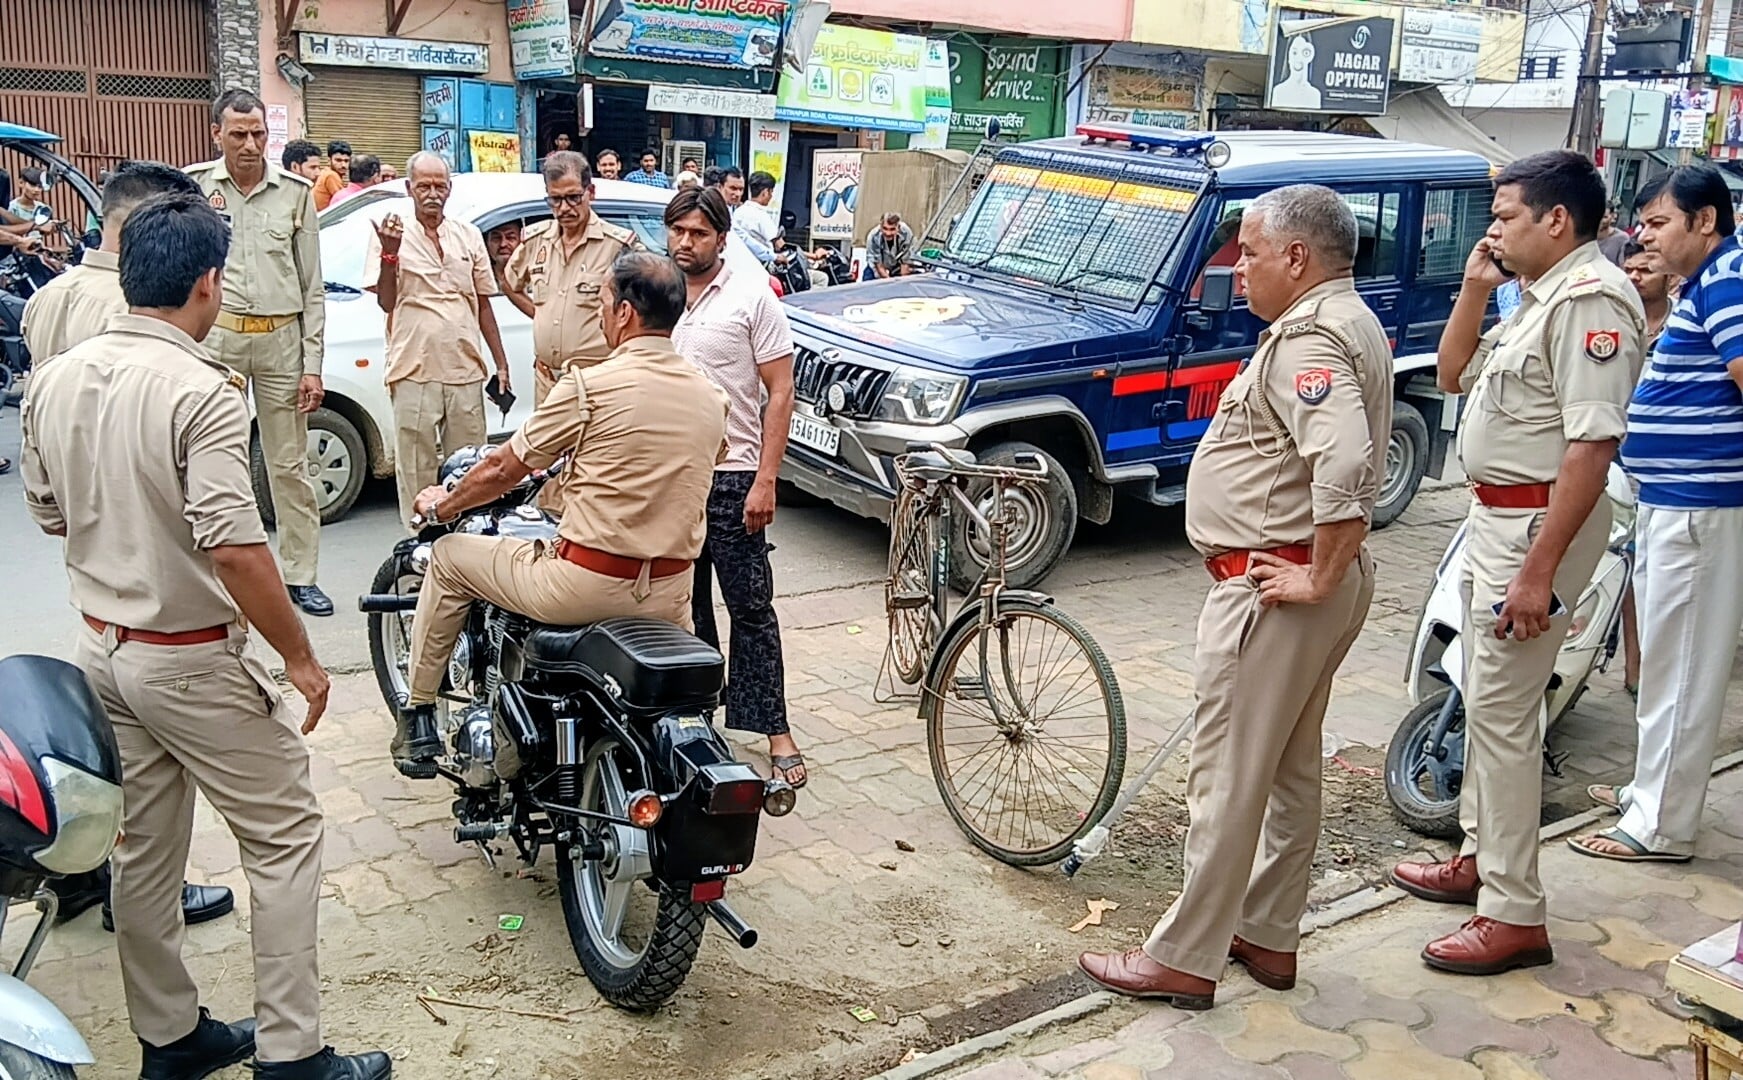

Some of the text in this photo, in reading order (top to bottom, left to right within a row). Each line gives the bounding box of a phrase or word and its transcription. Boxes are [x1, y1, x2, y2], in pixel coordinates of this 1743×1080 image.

[986, 46, 1040, 73] Sound
[1334, 52, 1381, 71] NAGAR
[1325, 70, 1385, 90] OPTICAL
[791, 417, 838, 450] 15AG1175
